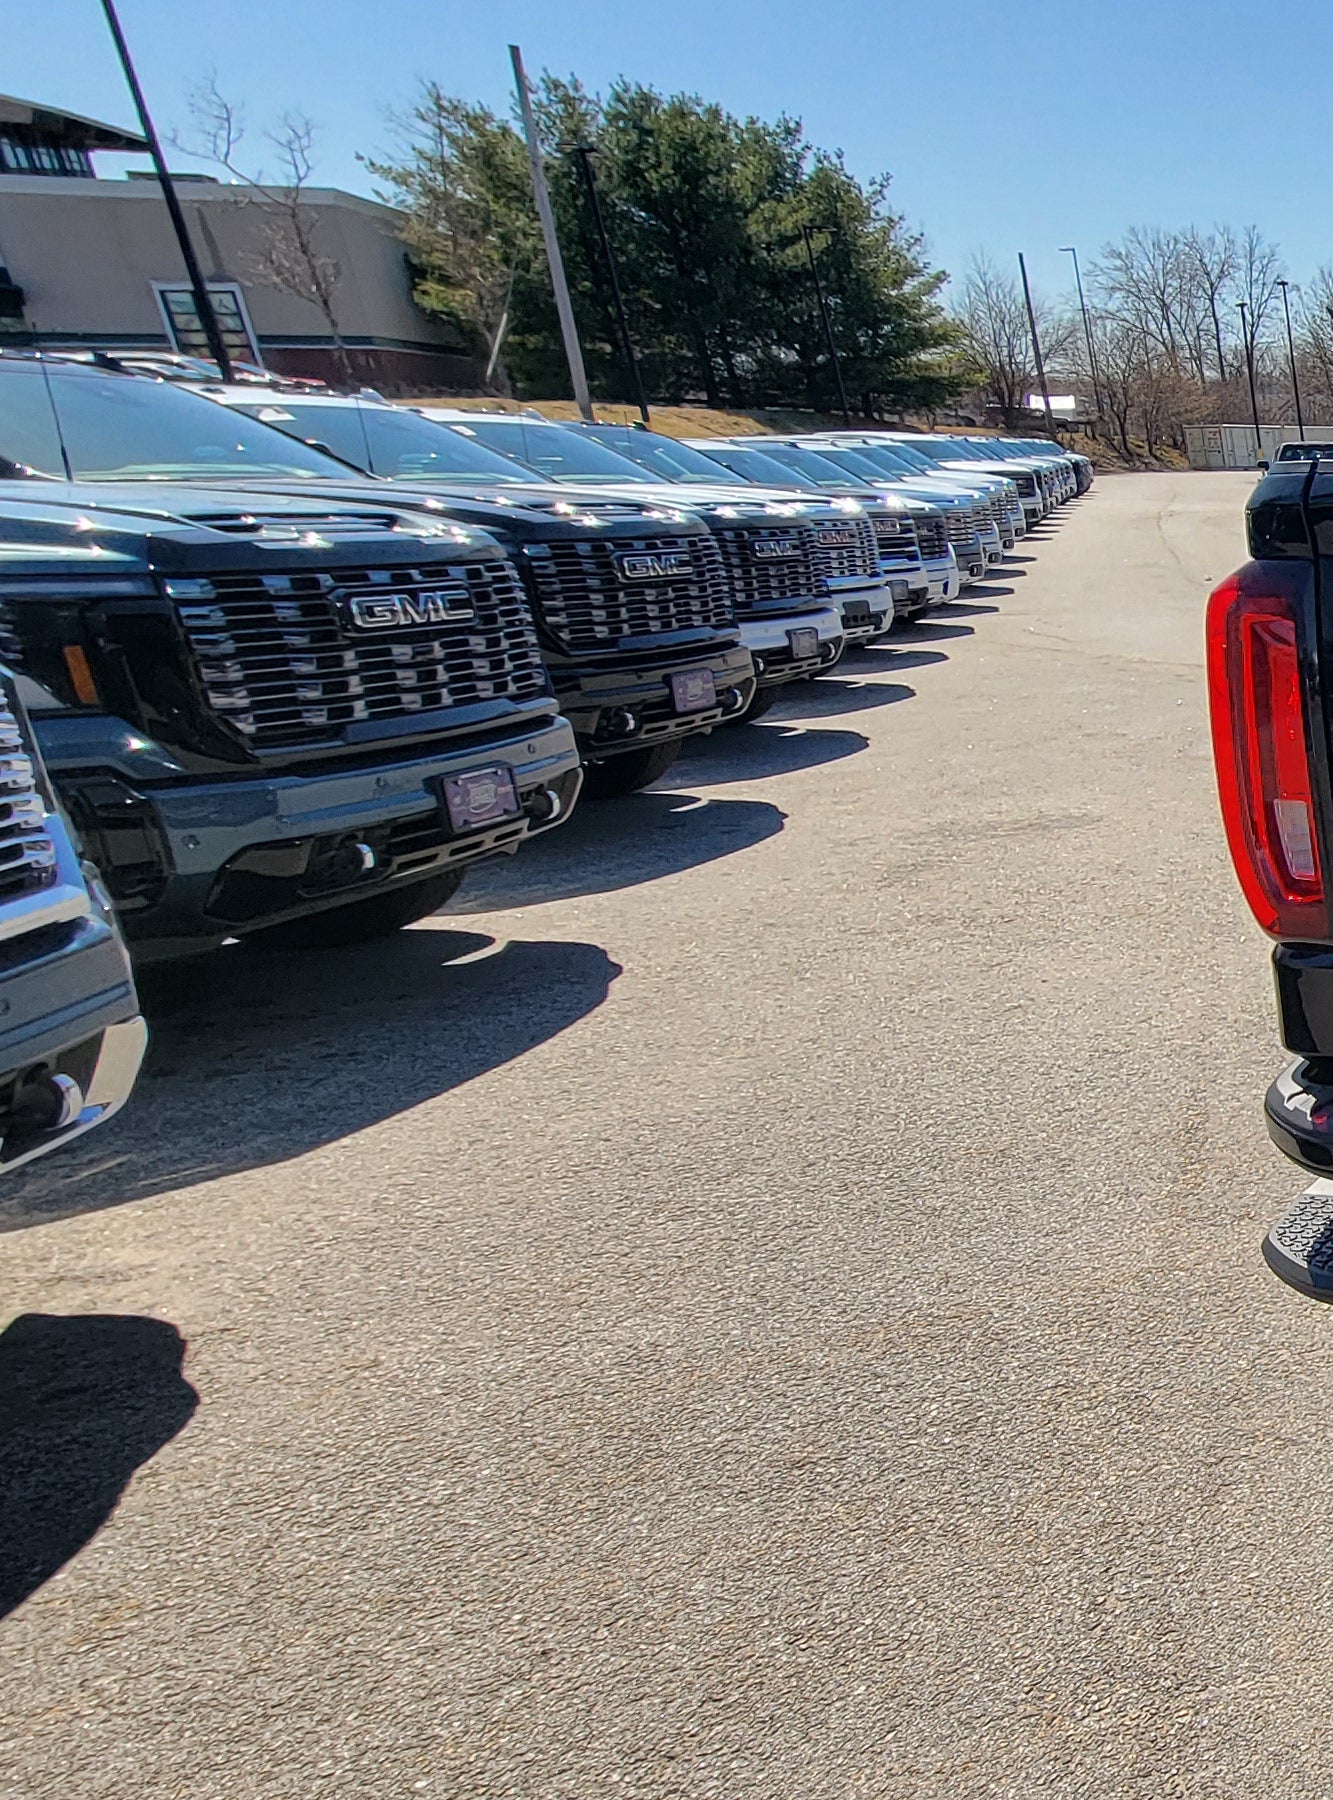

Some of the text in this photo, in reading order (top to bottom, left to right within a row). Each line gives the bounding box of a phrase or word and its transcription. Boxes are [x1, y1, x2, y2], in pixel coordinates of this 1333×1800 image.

[754, 540, 801, 557] GMC
[623, 553, 693, 577] GMC
[350, 589, 474, 628] GMC
